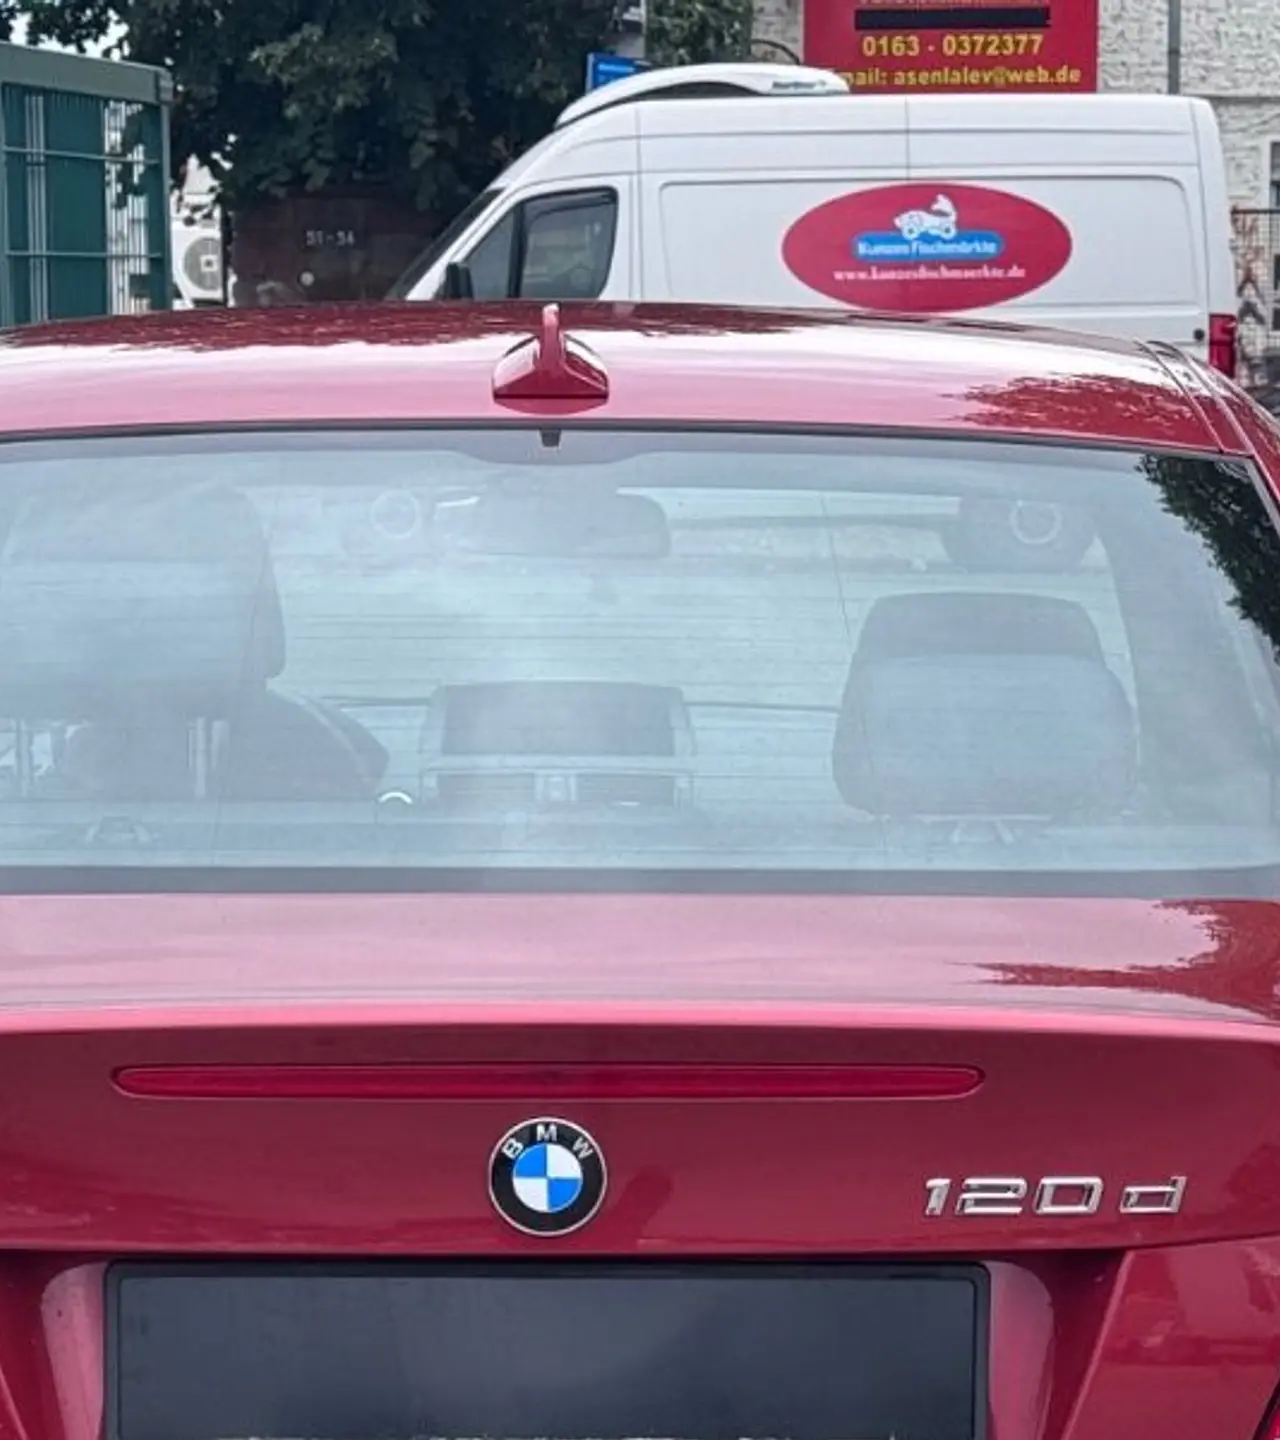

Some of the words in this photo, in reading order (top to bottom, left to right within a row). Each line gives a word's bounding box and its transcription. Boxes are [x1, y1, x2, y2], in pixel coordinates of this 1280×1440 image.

[862, 34, 920, 57] 0163
[942, 33, 1044, 57] 0372377
[501, 1123, 594, 1160] BMW
